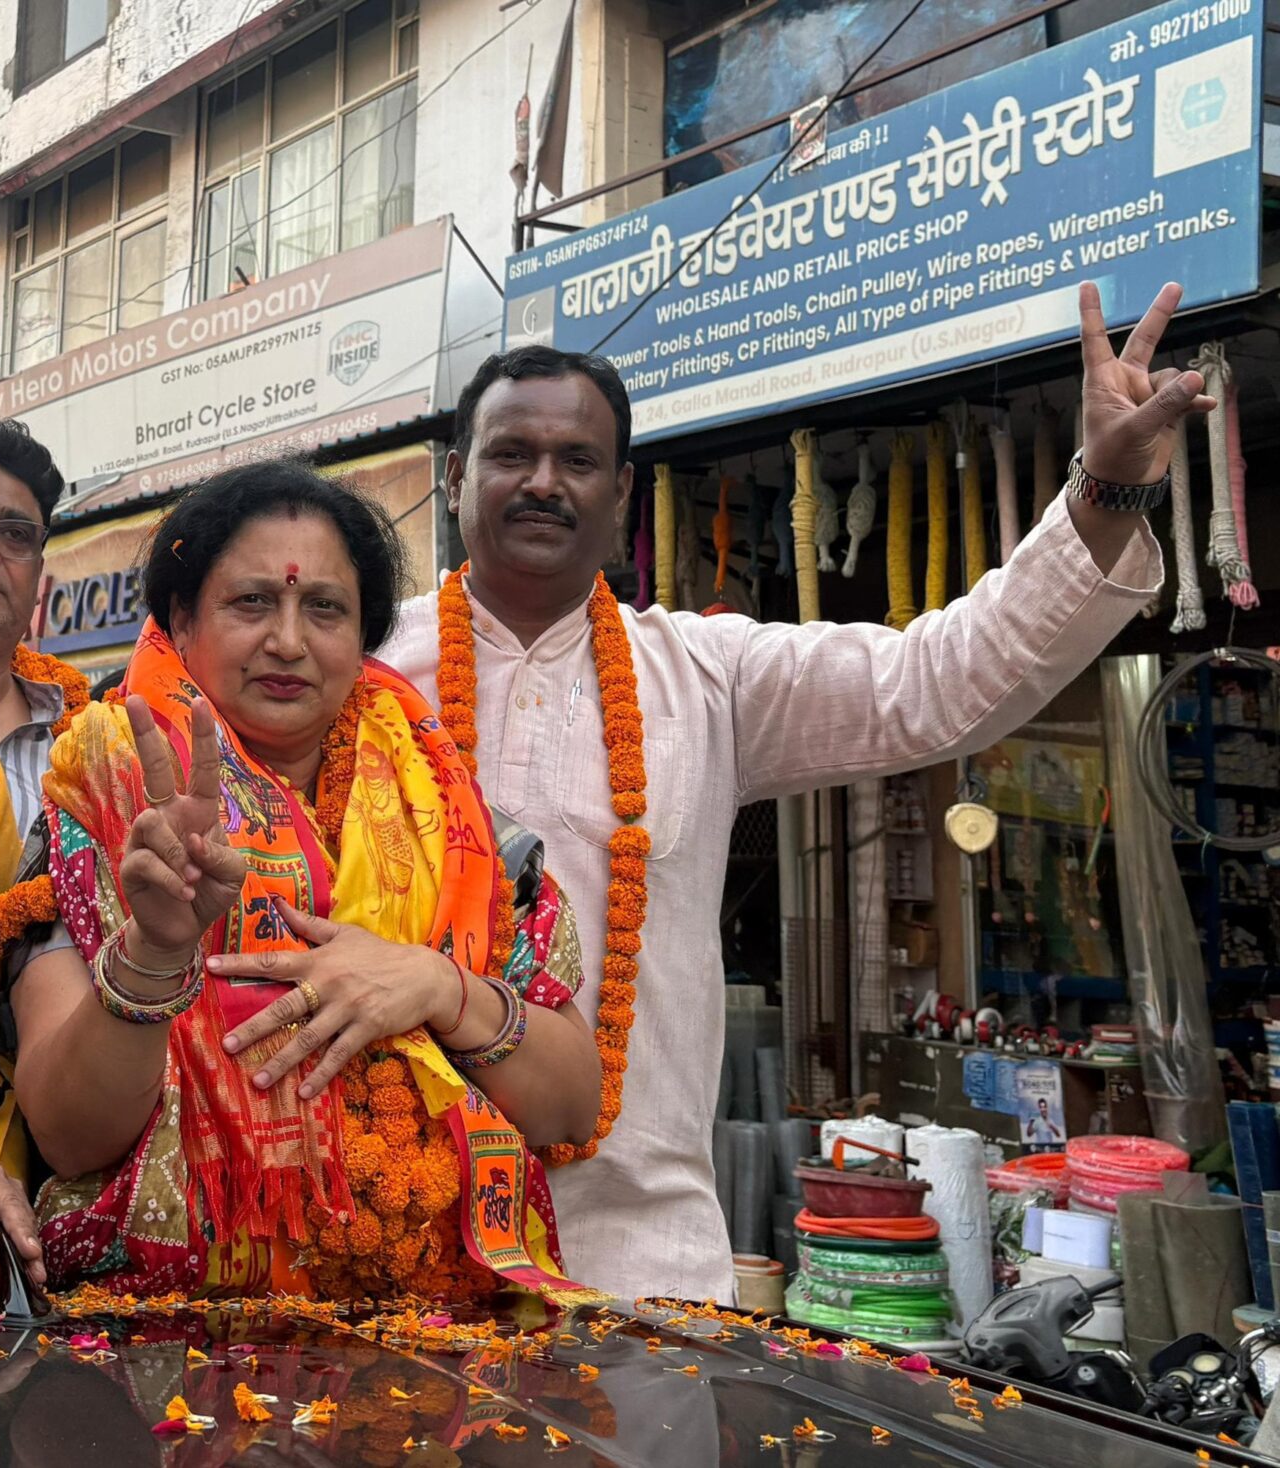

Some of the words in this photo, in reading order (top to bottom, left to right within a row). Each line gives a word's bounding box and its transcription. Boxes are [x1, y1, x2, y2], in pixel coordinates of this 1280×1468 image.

[1109, 30, 1144, 63] मो.
[849, 128, 871, 153] की
[561, 224, 674, 319] बालाजी
[821, 160, 901, 238] एण्ड
[1032, 68, 1140, 166] स्टोर
[624, 367, 669, 392] nitary
[672, 354, 734, 379] Fittings,
[737, 343, 759, 362] CP
[763, 325, 830, 356] Fittings,
[835, 311, 857, 335] All
[861, 303, 907, 331] Type
[910, 289, 929, 314] of
[932, 281, 974, 313] Pipe
[978, 257, 1055, 293] Fittings
[1060, 250, 1074, 272] &
[1079, 231, 1149, 265] Water
[1155, 207, 1236, 245] Tanks.
[652, 333, 691, 359] Tools
[694, 327, 704, 345] &
[708, 316, 750, 343] Hand
[754, 307, 801, 330] Tools,
[805, 285, 857, 315] Chain
[862, 267, 922, 299] Pulley,
[927, 252, 971, 280] Wire
[976, 231, 1044, 265] Ropes,
[1049, 190, 1164, 242] Wiremesh
[656, 281, 748, 325] WHOLESALE
[752, 268, 789, 298] AND
[794, 249, 851, 283] RETAIL
[856, 228, 910, 263] PRICE
[914, 210, 969, 245] SHOP
[11, 370, 63, 408] Hero
[70, 334, 157, 386] Motors
[166, 272, 331, 350] Company
[161, 368, 182, 385] GST
[184, 362, 204, 378] No:
[328, 340, 379, 373] INSIDE
[135, 410, 192, 445] Bharat
[198, 395, 255, 428] Cycle
[262, 377, 316, 408] Store
[672, 389, 711, 415] Galla
[770, 367, 816, 392] Road,
[821, 344, 906, 378] Rudrapur
